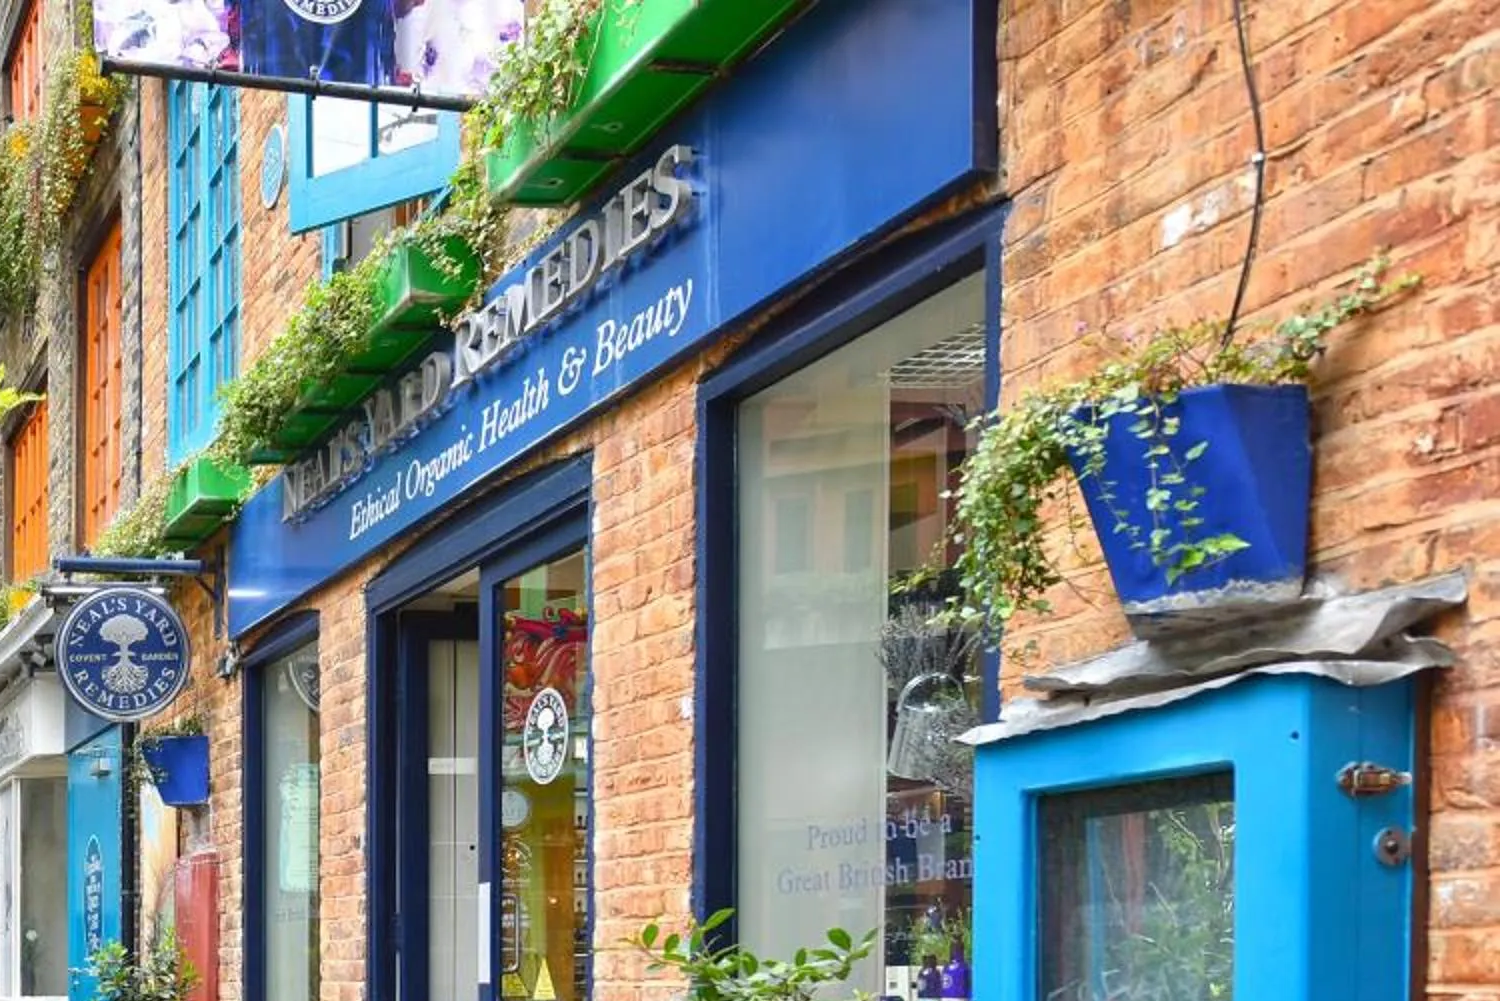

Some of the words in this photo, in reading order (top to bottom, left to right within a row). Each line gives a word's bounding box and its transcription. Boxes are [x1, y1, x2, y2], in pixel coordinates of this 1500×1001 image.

[450, 144, 694, 390] REMEDIES
[349, 471, 401, 541] Ethical
[405, 423, 474, 501] Organic
[475, 366, 550, 454] Health
[557, 346, 587, 397] &
[591, 277, 693, 378] Beauty
[69, 597, 128, 647] NEAL'S
[135, 599, 177, 647] YARD
[69, 653, 107, 663] COVENT
[73, 667, 176, 709] REMEDIES
[807, 819, 869, 850] Proud
[777, 864, 831, 894] Great
[917, 853, 974, 881] Bran
